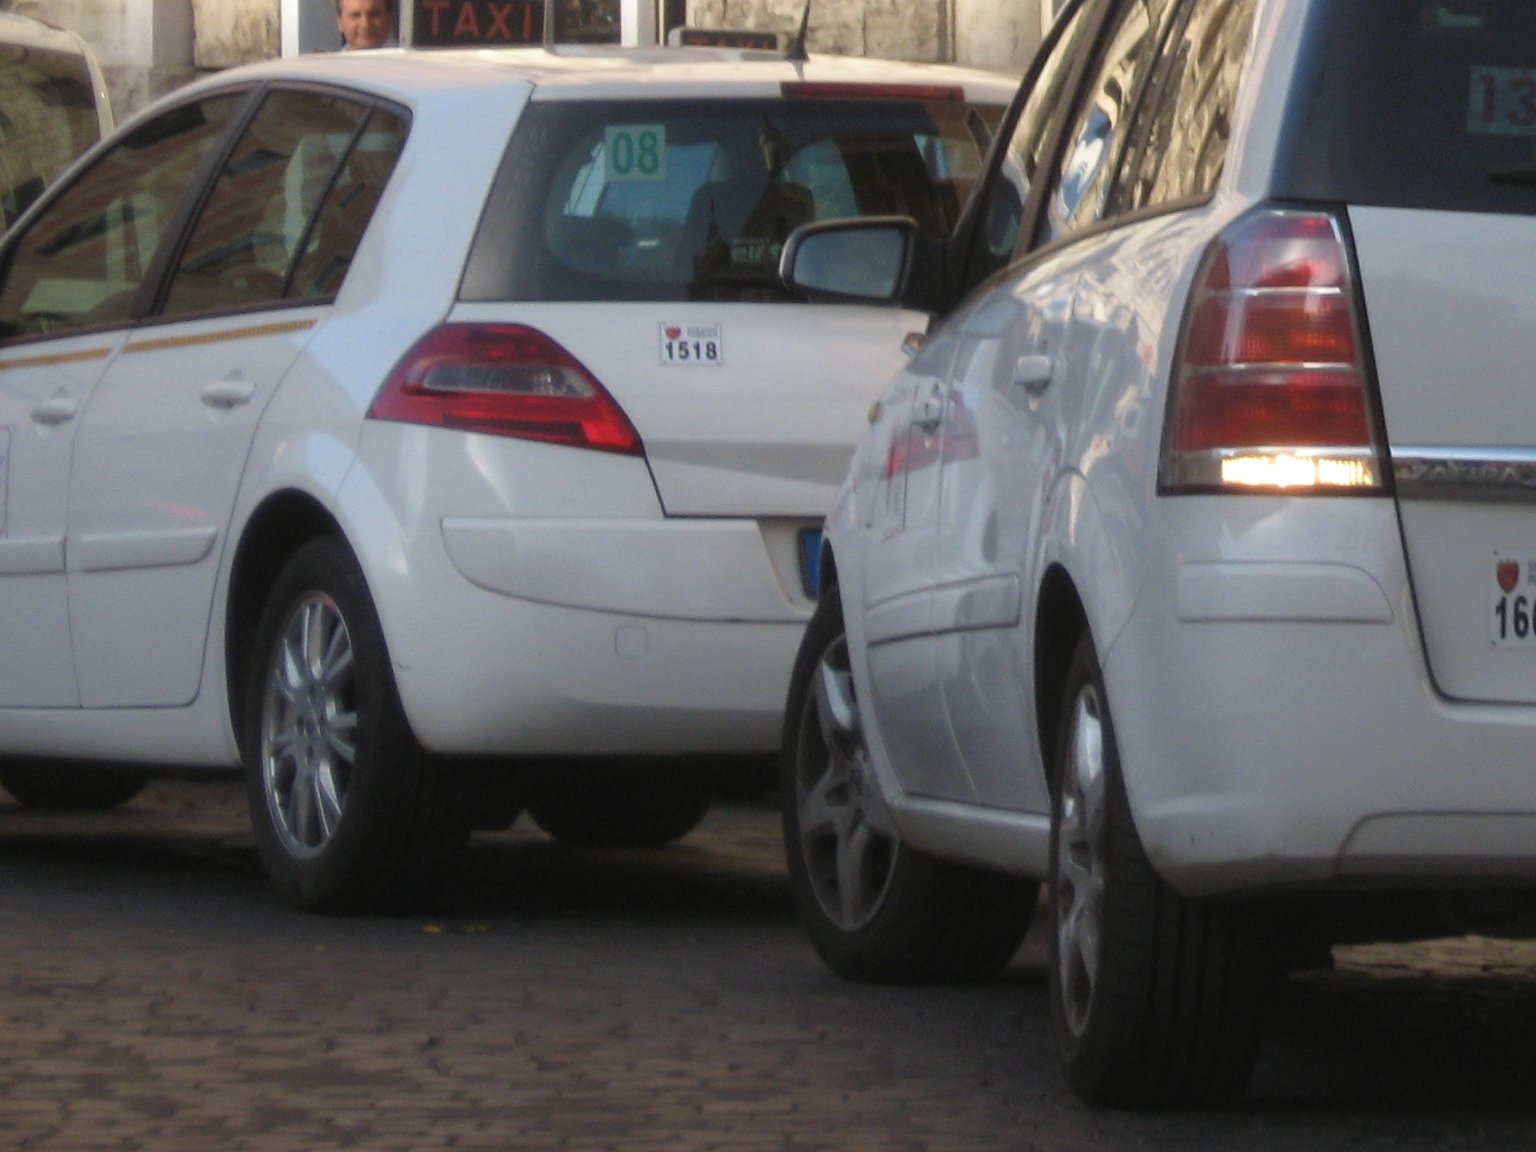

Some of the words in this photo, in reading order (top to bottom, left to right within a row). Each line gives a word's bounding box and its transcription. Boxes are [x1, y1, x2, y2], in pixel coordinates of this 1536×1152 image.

[422, 0, 533, 40] TAXI
[611, 130, 661, 177] 08
[665, 340, 718, 362] 1518
